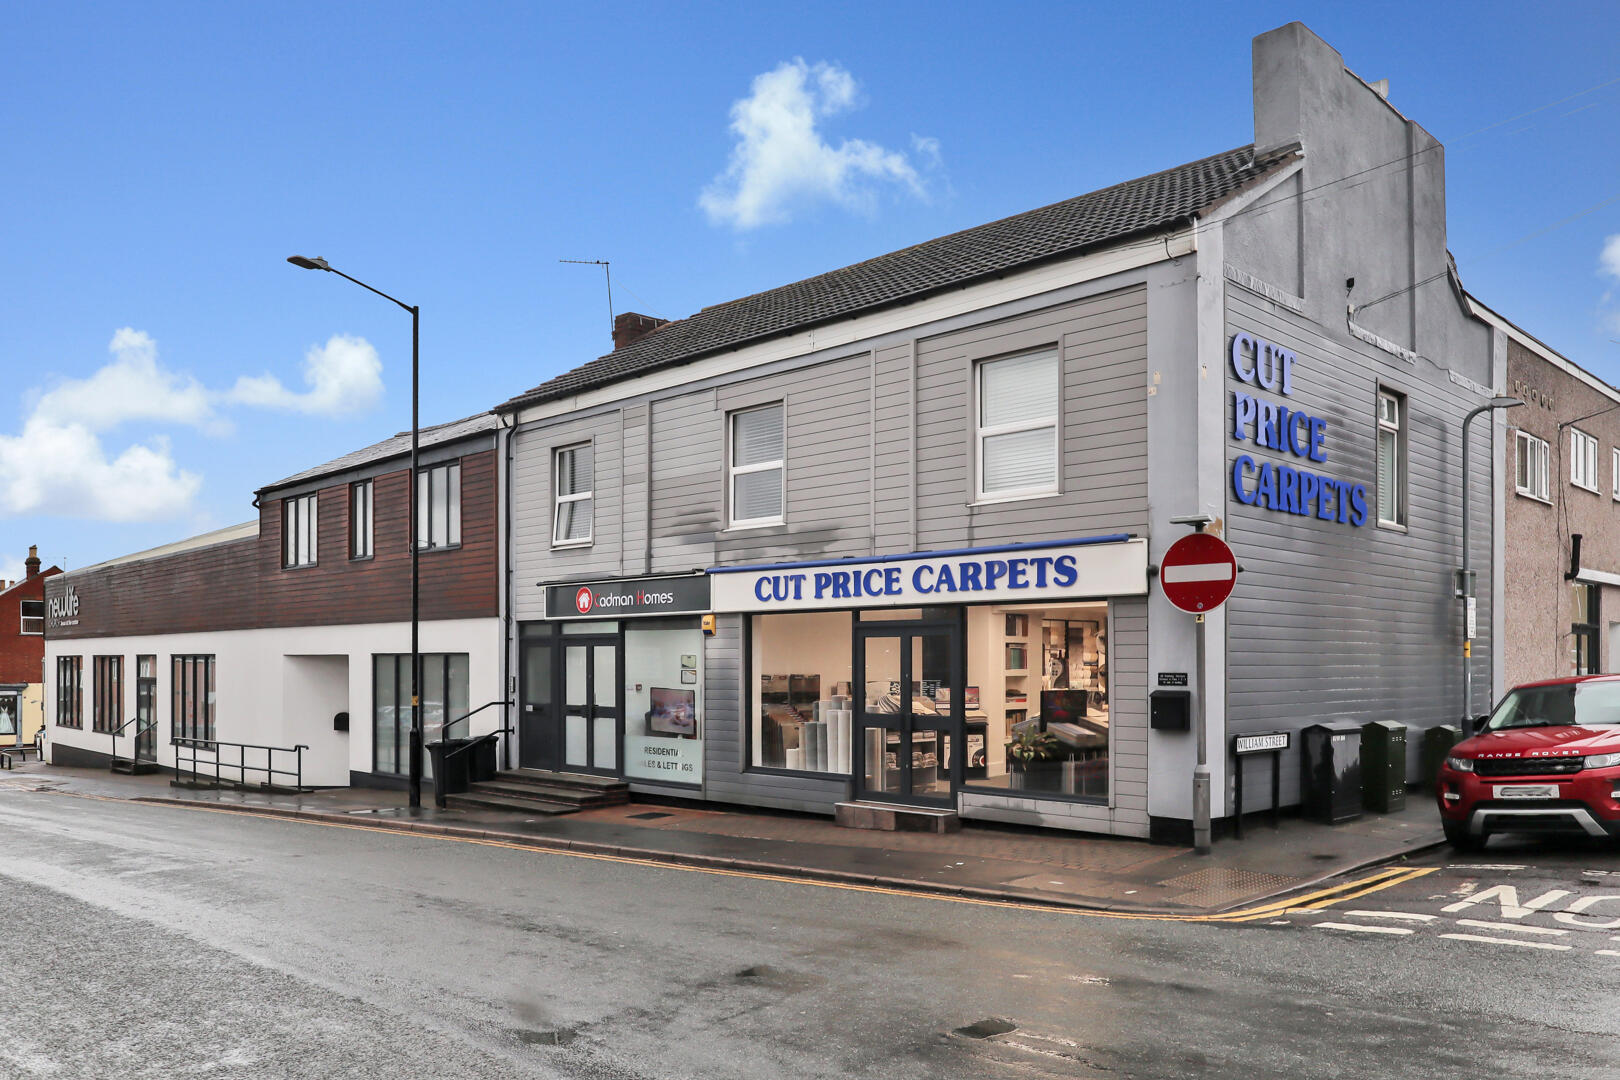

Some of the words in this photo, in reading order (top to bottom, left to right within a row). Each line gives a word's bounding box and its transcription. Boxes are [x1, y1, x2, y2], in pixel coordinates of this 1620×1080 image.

[1232, 332, 1297, 395] CUT
[1234, 391, 1328, 463] PRICE
[1234, 454, 1369, 527] CARPETS
[594, 592, 634, 608] Cadman
[636, 589, 674, 606] Homes
[754, 574, 806, 602] CUT
[813, 567, 903, 599] PRICE
[911, 555, 1078, 594] CARPETS
[1237, 737, 1264, 750] WILLIAM
[1265, 735, 1286, 748] STREET
